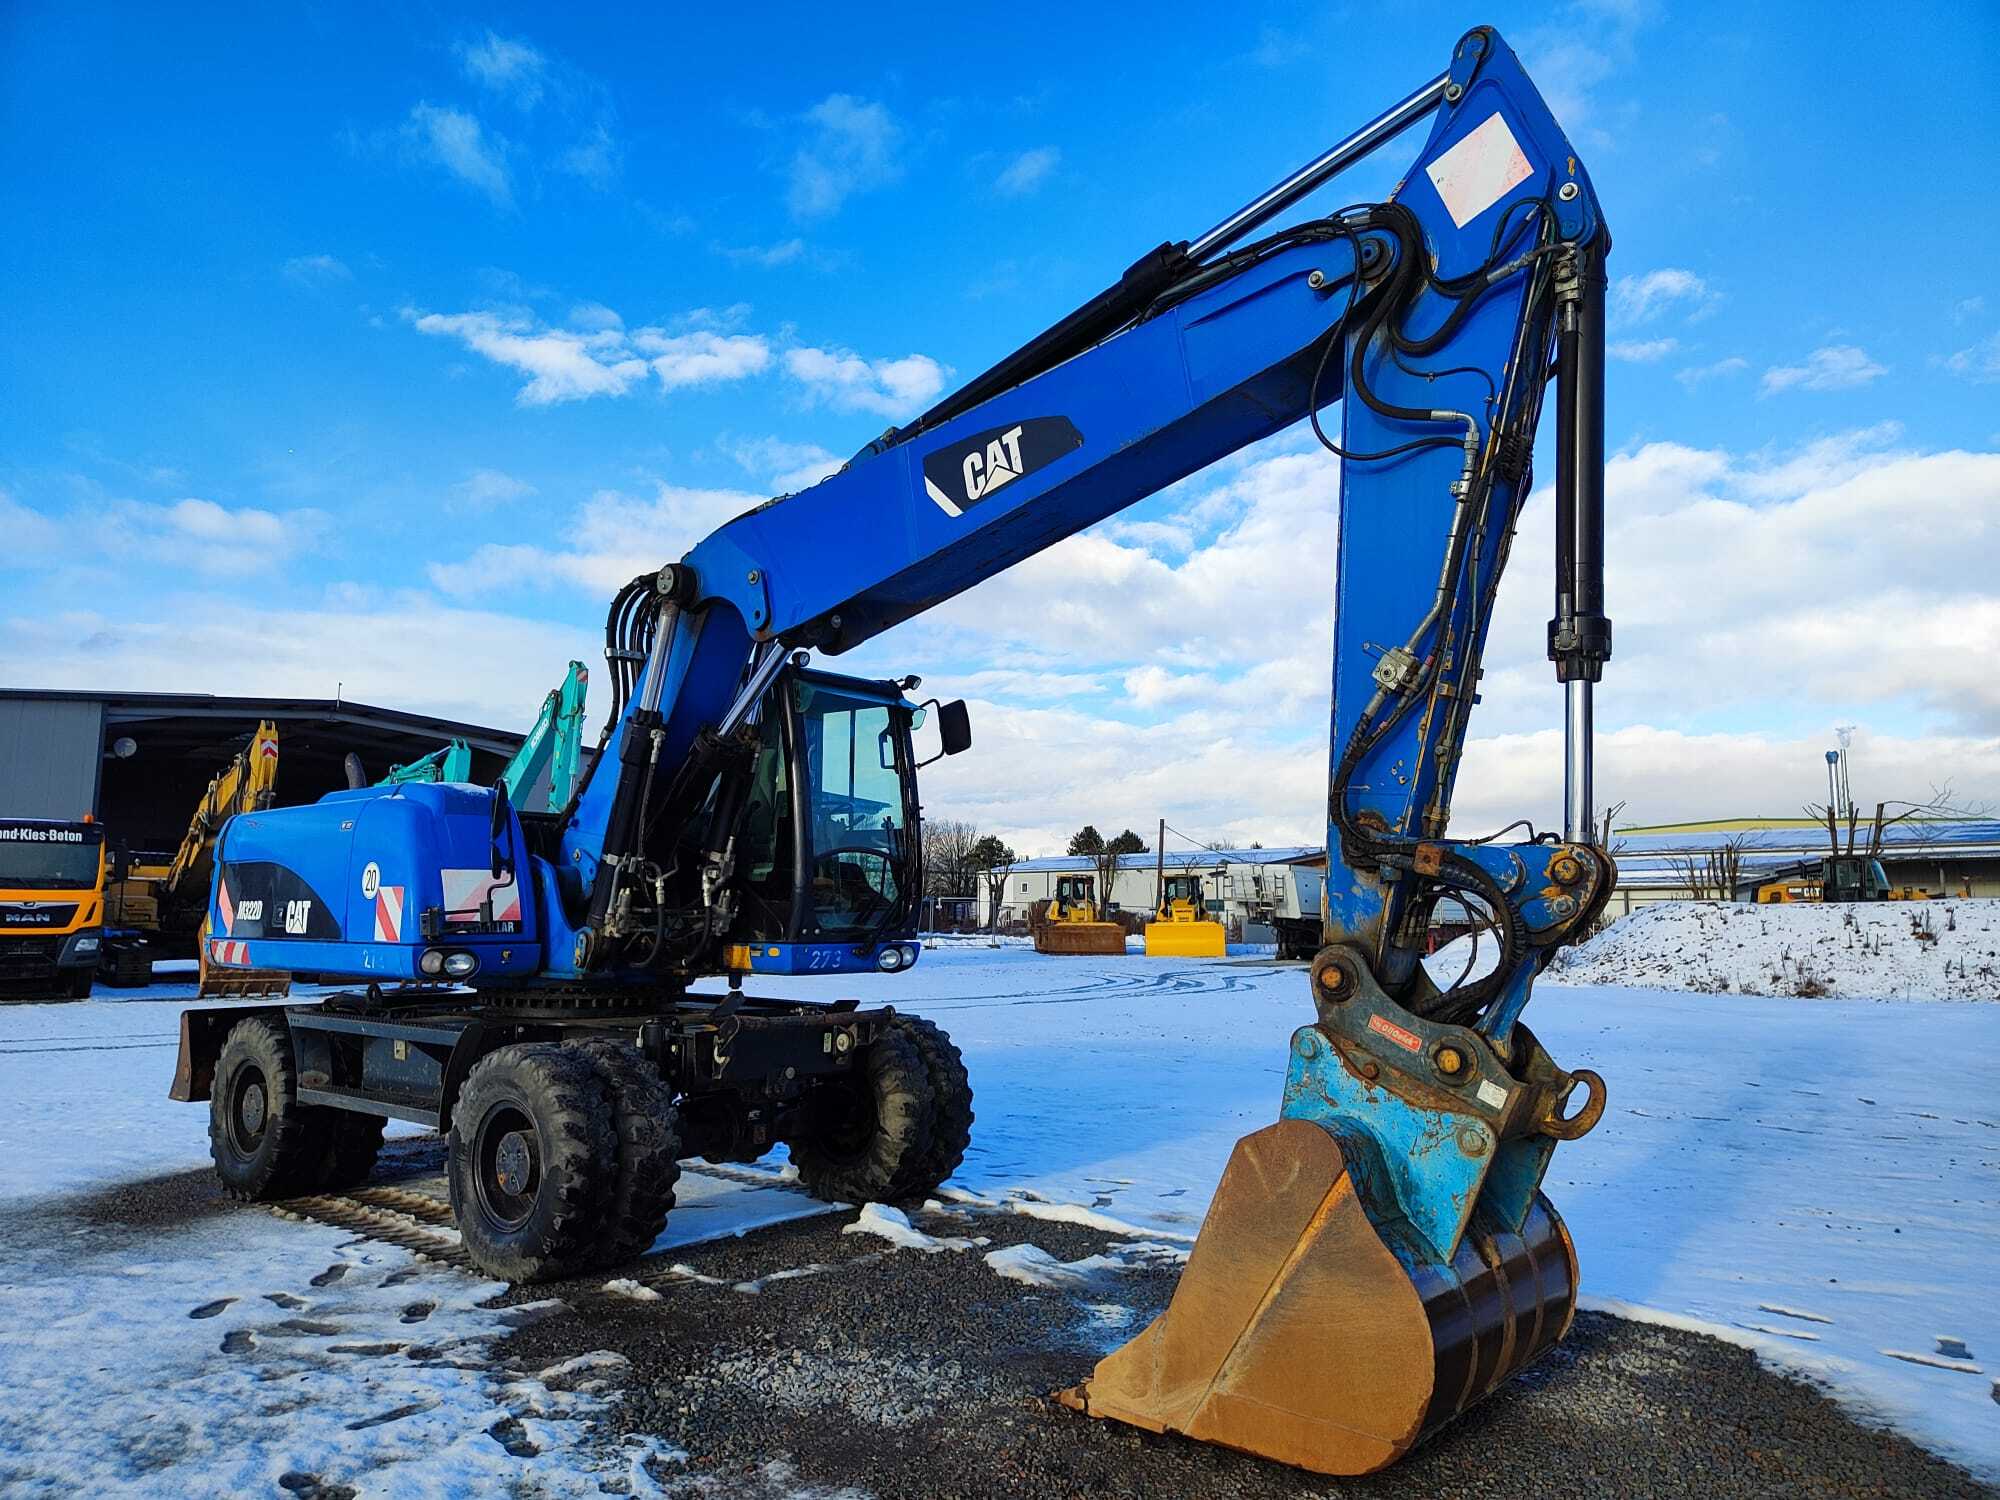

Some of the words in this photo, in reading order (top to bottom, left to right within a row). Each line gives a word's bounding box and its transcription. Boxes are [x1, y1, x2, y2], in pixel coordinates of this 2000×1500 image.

[963, 425, 1024, 500] CAT
[365, 870, 377, 891] 20
[5, 913, 50, 922] MAN
[237, 900, 263, 920] M322D
[286, 900, 311, 934] CAT
[809, 950, 841, 968] 273
